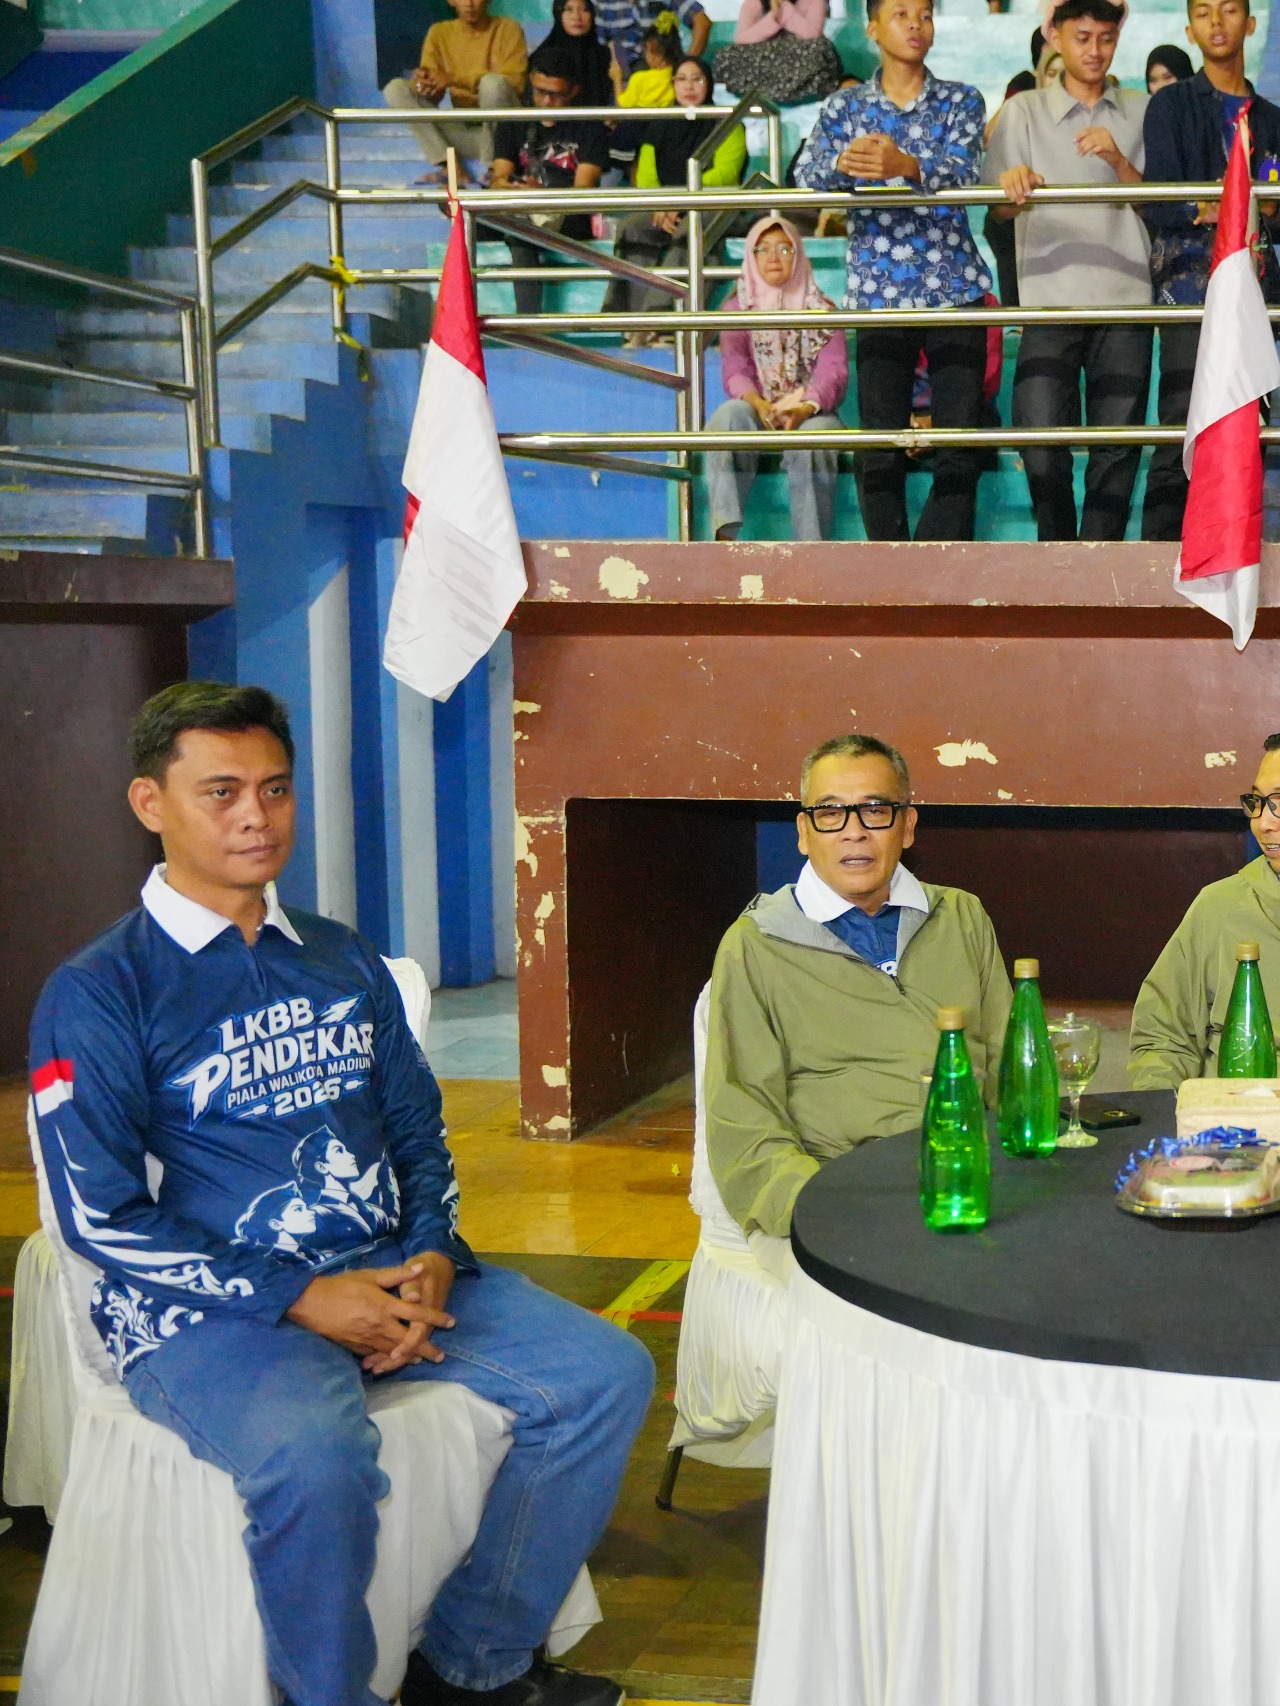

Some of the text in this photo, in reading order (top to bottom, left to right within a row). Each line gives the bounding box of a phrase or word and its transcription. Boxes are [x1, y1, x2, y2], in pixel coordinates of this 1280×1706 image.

[219, 997, 315, 1052] LKBB
[171, 1022, 376, 1120] PENDEKAR
[227, 1084, 267, 1109] PIALA
[327, 1056, 371, 1076] MADIUN
[273, 1076, 342, 1117] 2026
